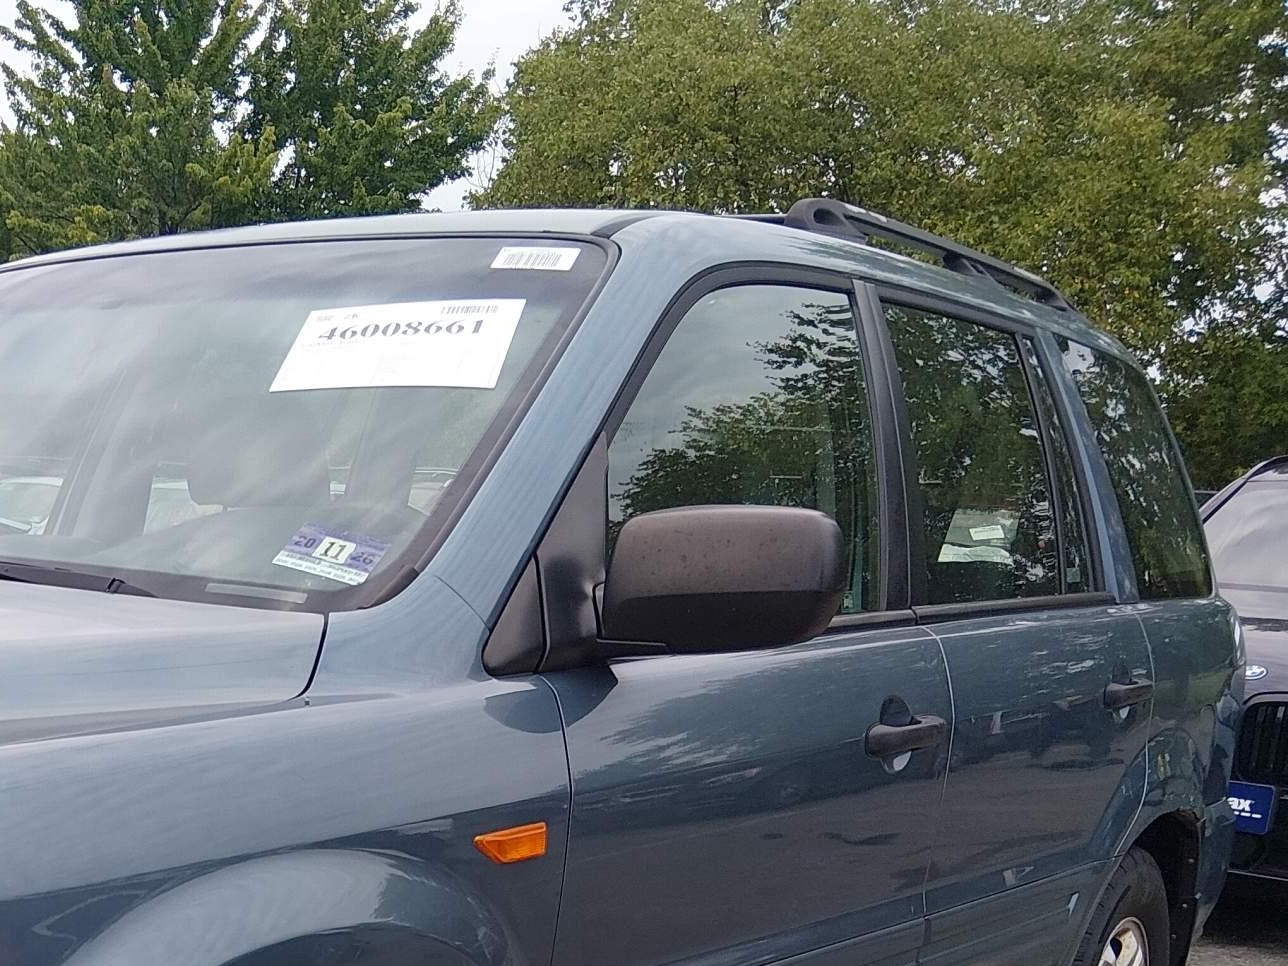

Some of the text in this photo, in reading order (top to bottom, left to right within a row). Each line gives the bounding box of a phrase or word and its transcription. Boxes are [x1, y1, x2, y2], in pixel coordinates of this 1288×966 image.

[317, 319, 484, 340] 46008661
[294, 535, 317, 549] 20
[320, 541, 347, 561] 11
